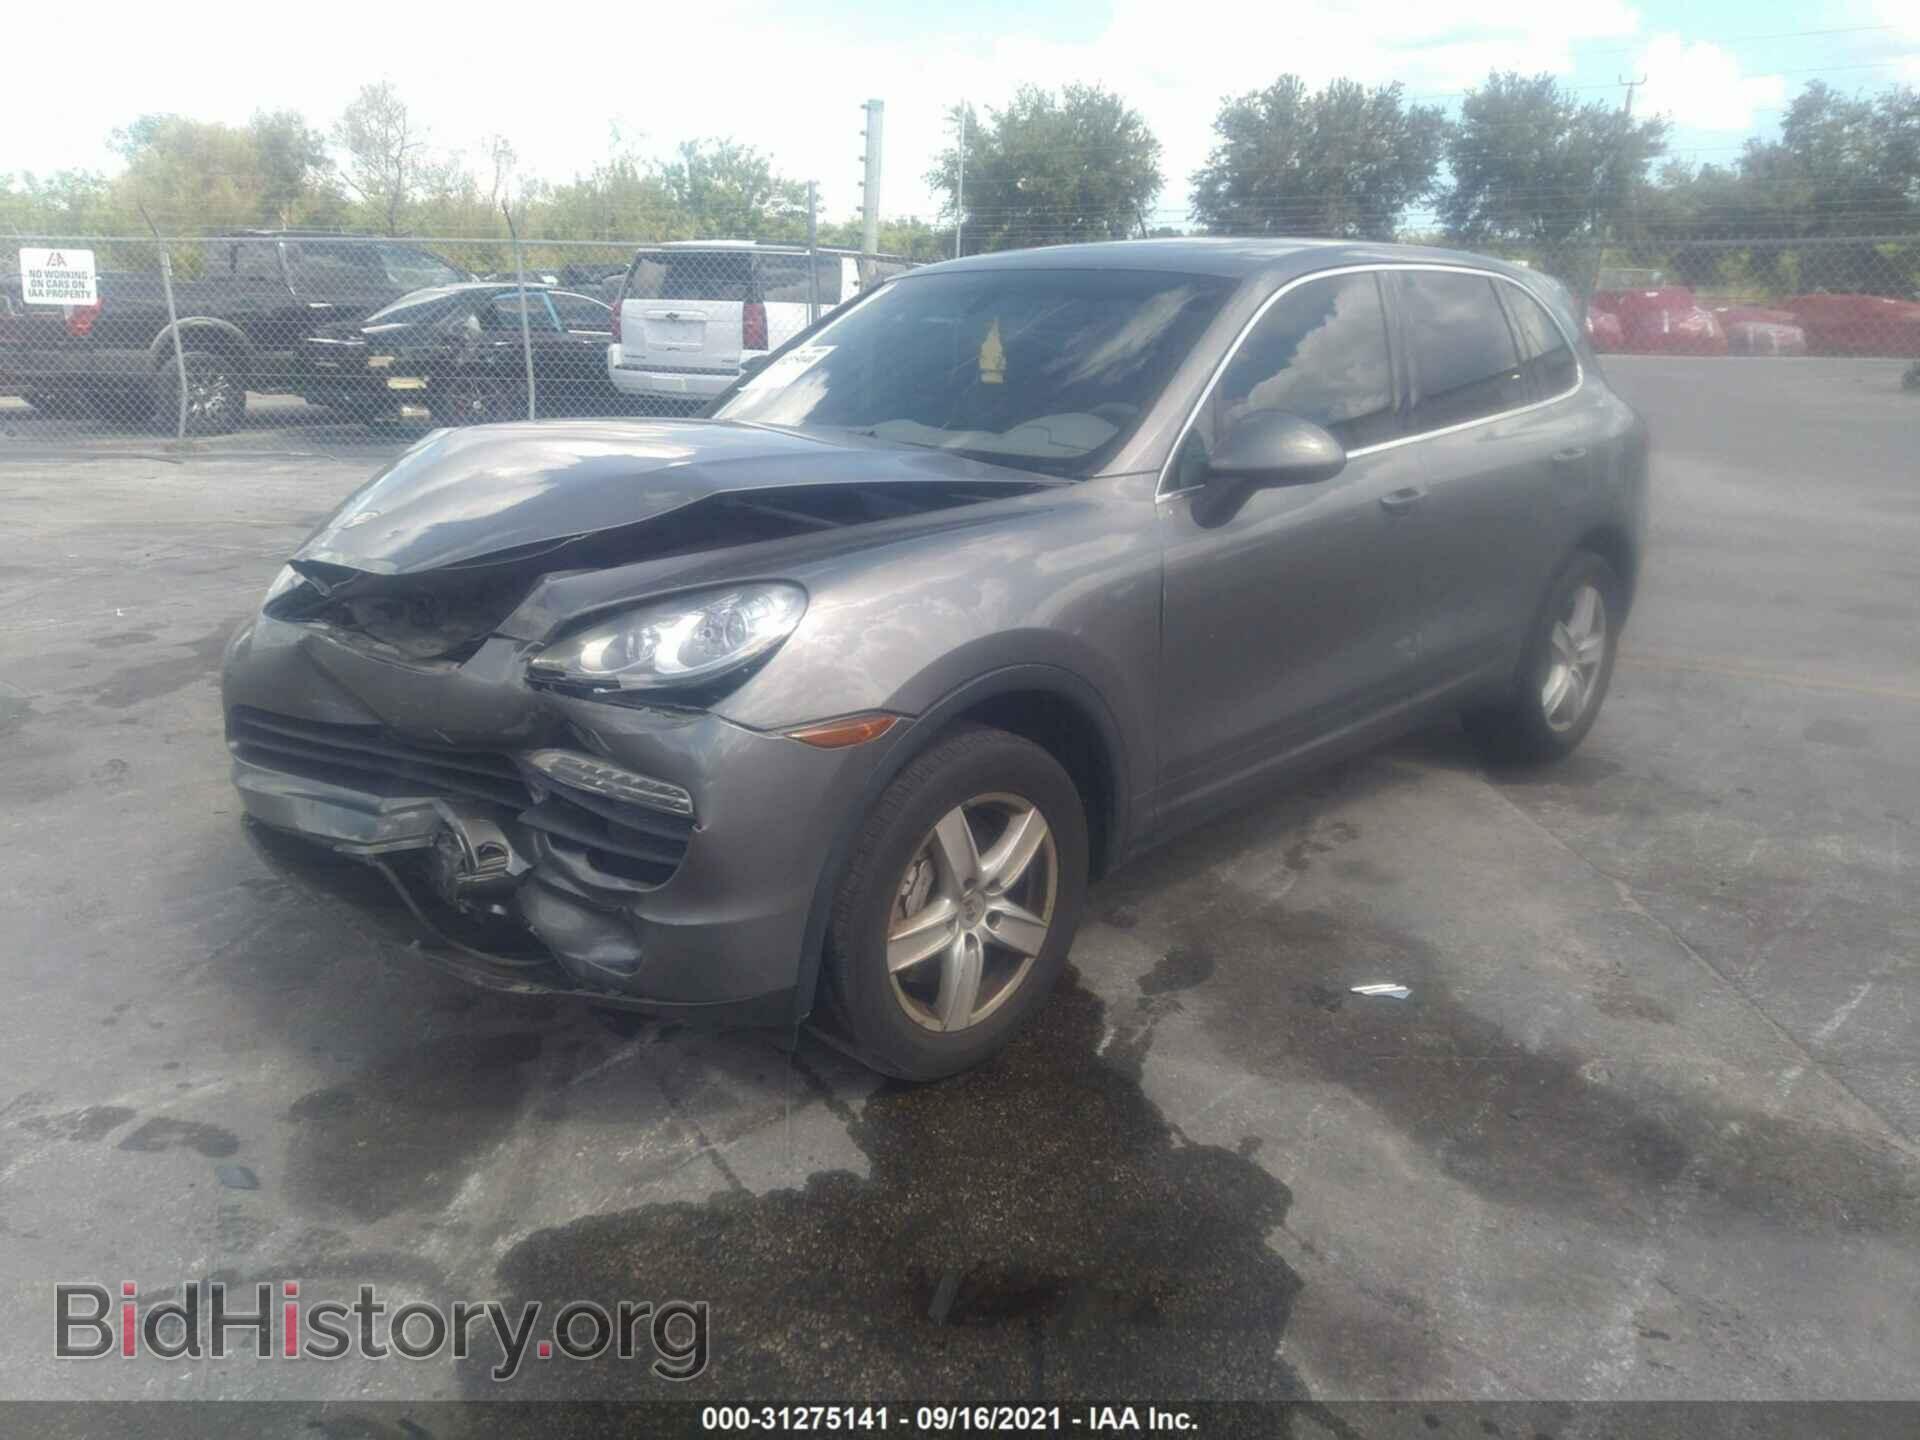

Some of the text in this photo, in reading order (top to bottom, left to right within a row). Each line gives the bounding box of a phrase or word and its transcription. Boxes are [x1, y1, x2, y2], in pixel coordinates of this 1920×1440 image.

[29, 270, 88, 280] NO WORKING
[31, 279, 85, 289] ON CARS ON
[28, 289, 91, 299] IAA PROPERTY
